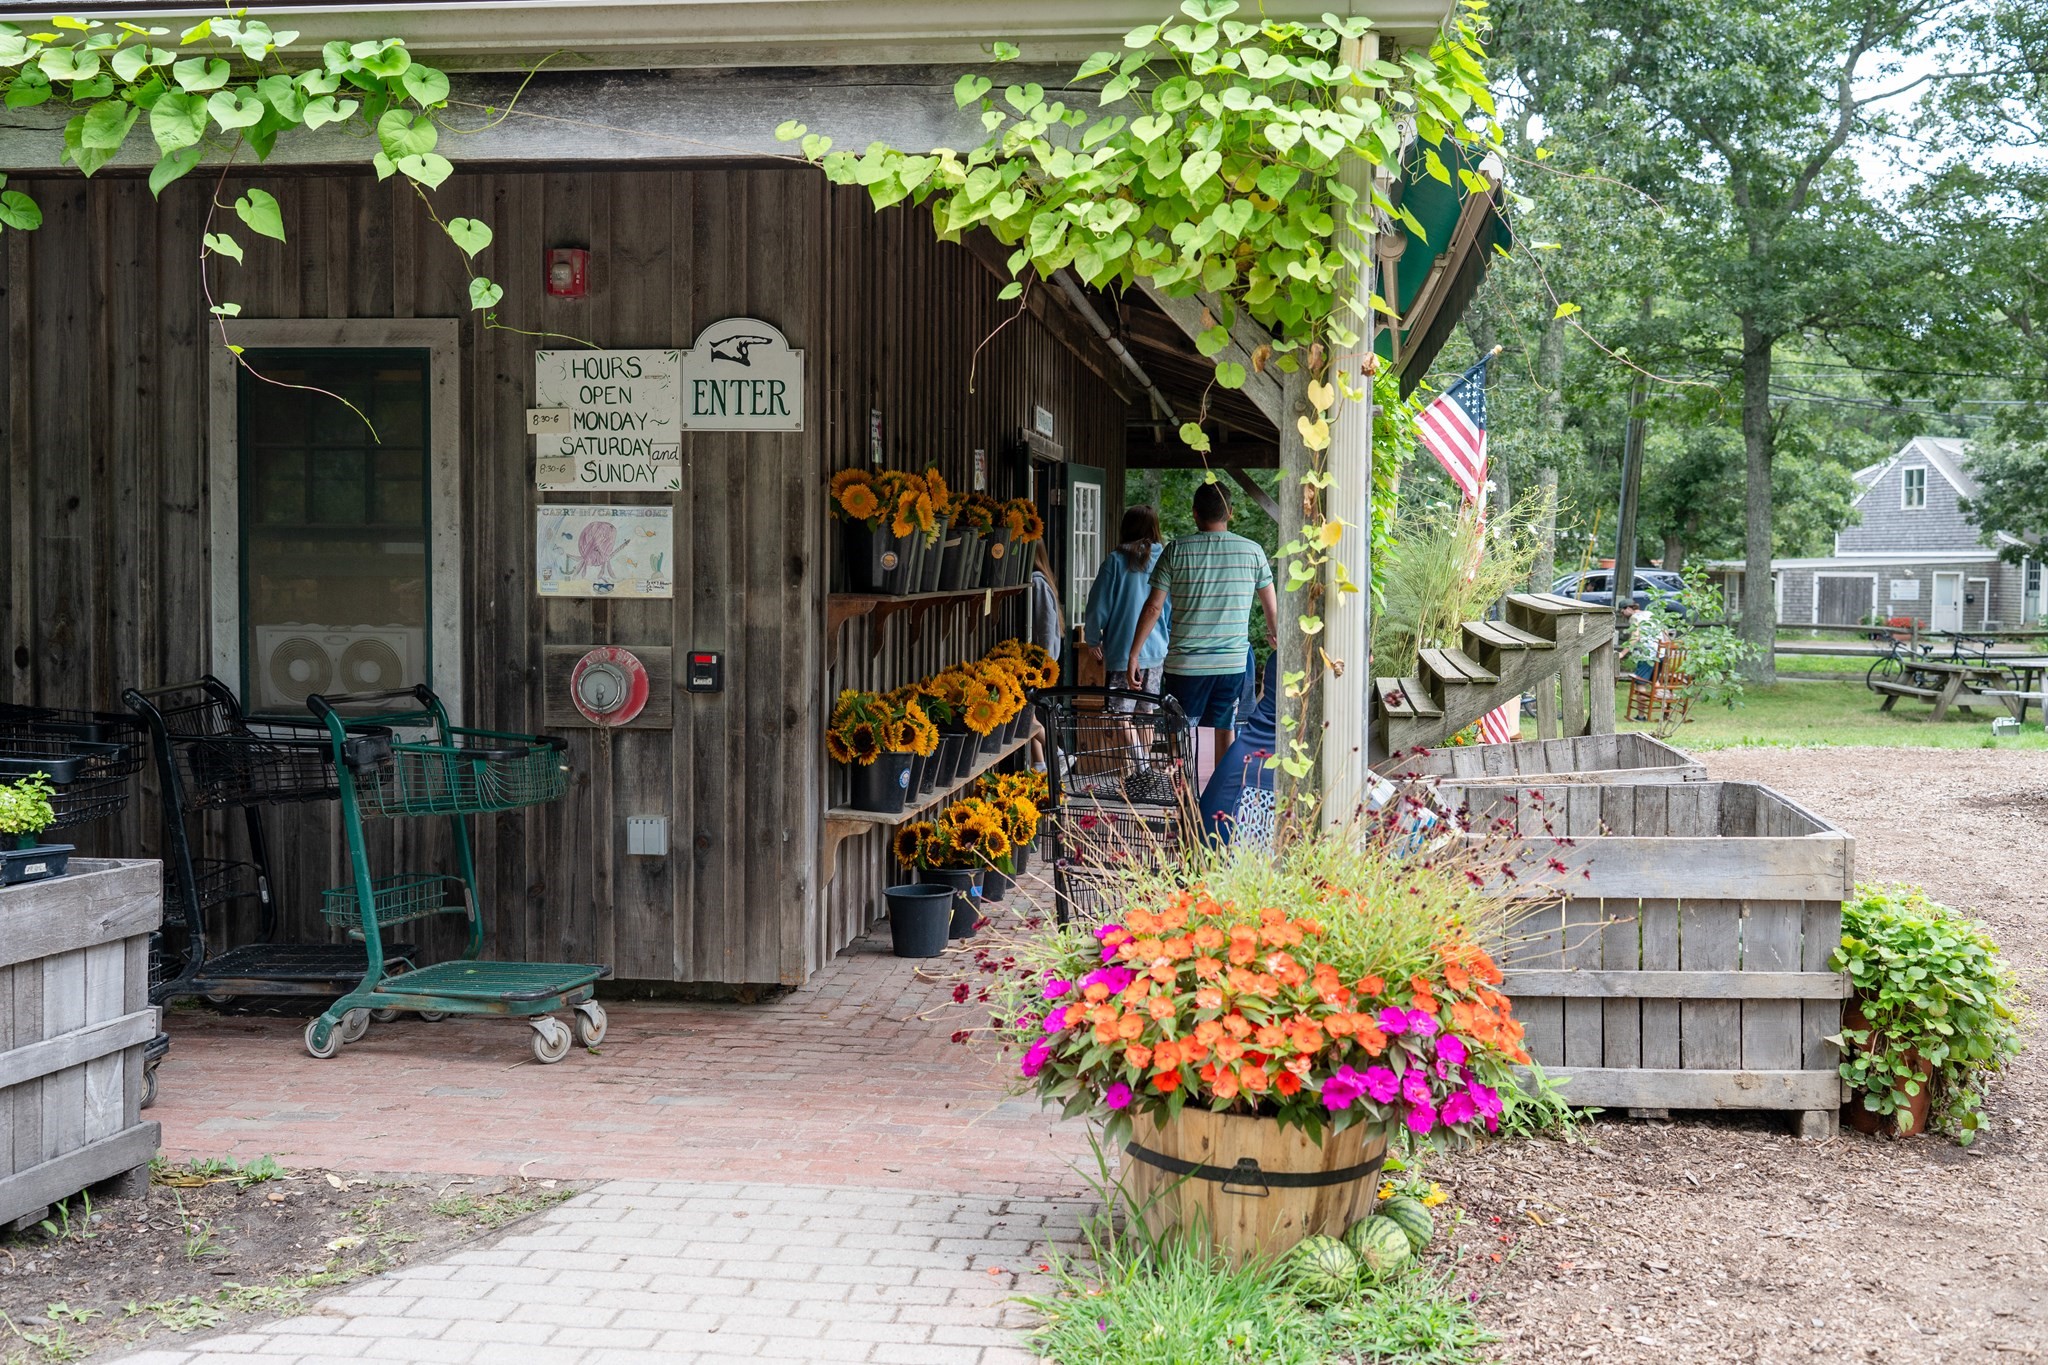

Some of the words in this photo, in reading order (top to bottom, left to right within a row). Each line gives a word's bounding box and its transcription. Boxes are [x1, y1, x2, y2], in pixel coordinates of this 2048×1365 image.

[572, 356, 642, 380] HOURS
[580, 385, 632, 404] OPEN
[691, 379, 791, 417] ENTER
[574, 411, 648, 431] MONDAY
[560, 436, 653, 456] SATURDAY
[651, 446, 679, 461] and
[580, 461, 659, 483] SUNDAY
[542, 508, 576, 517] CARRY
[636, 508, 668, 517] HOME
